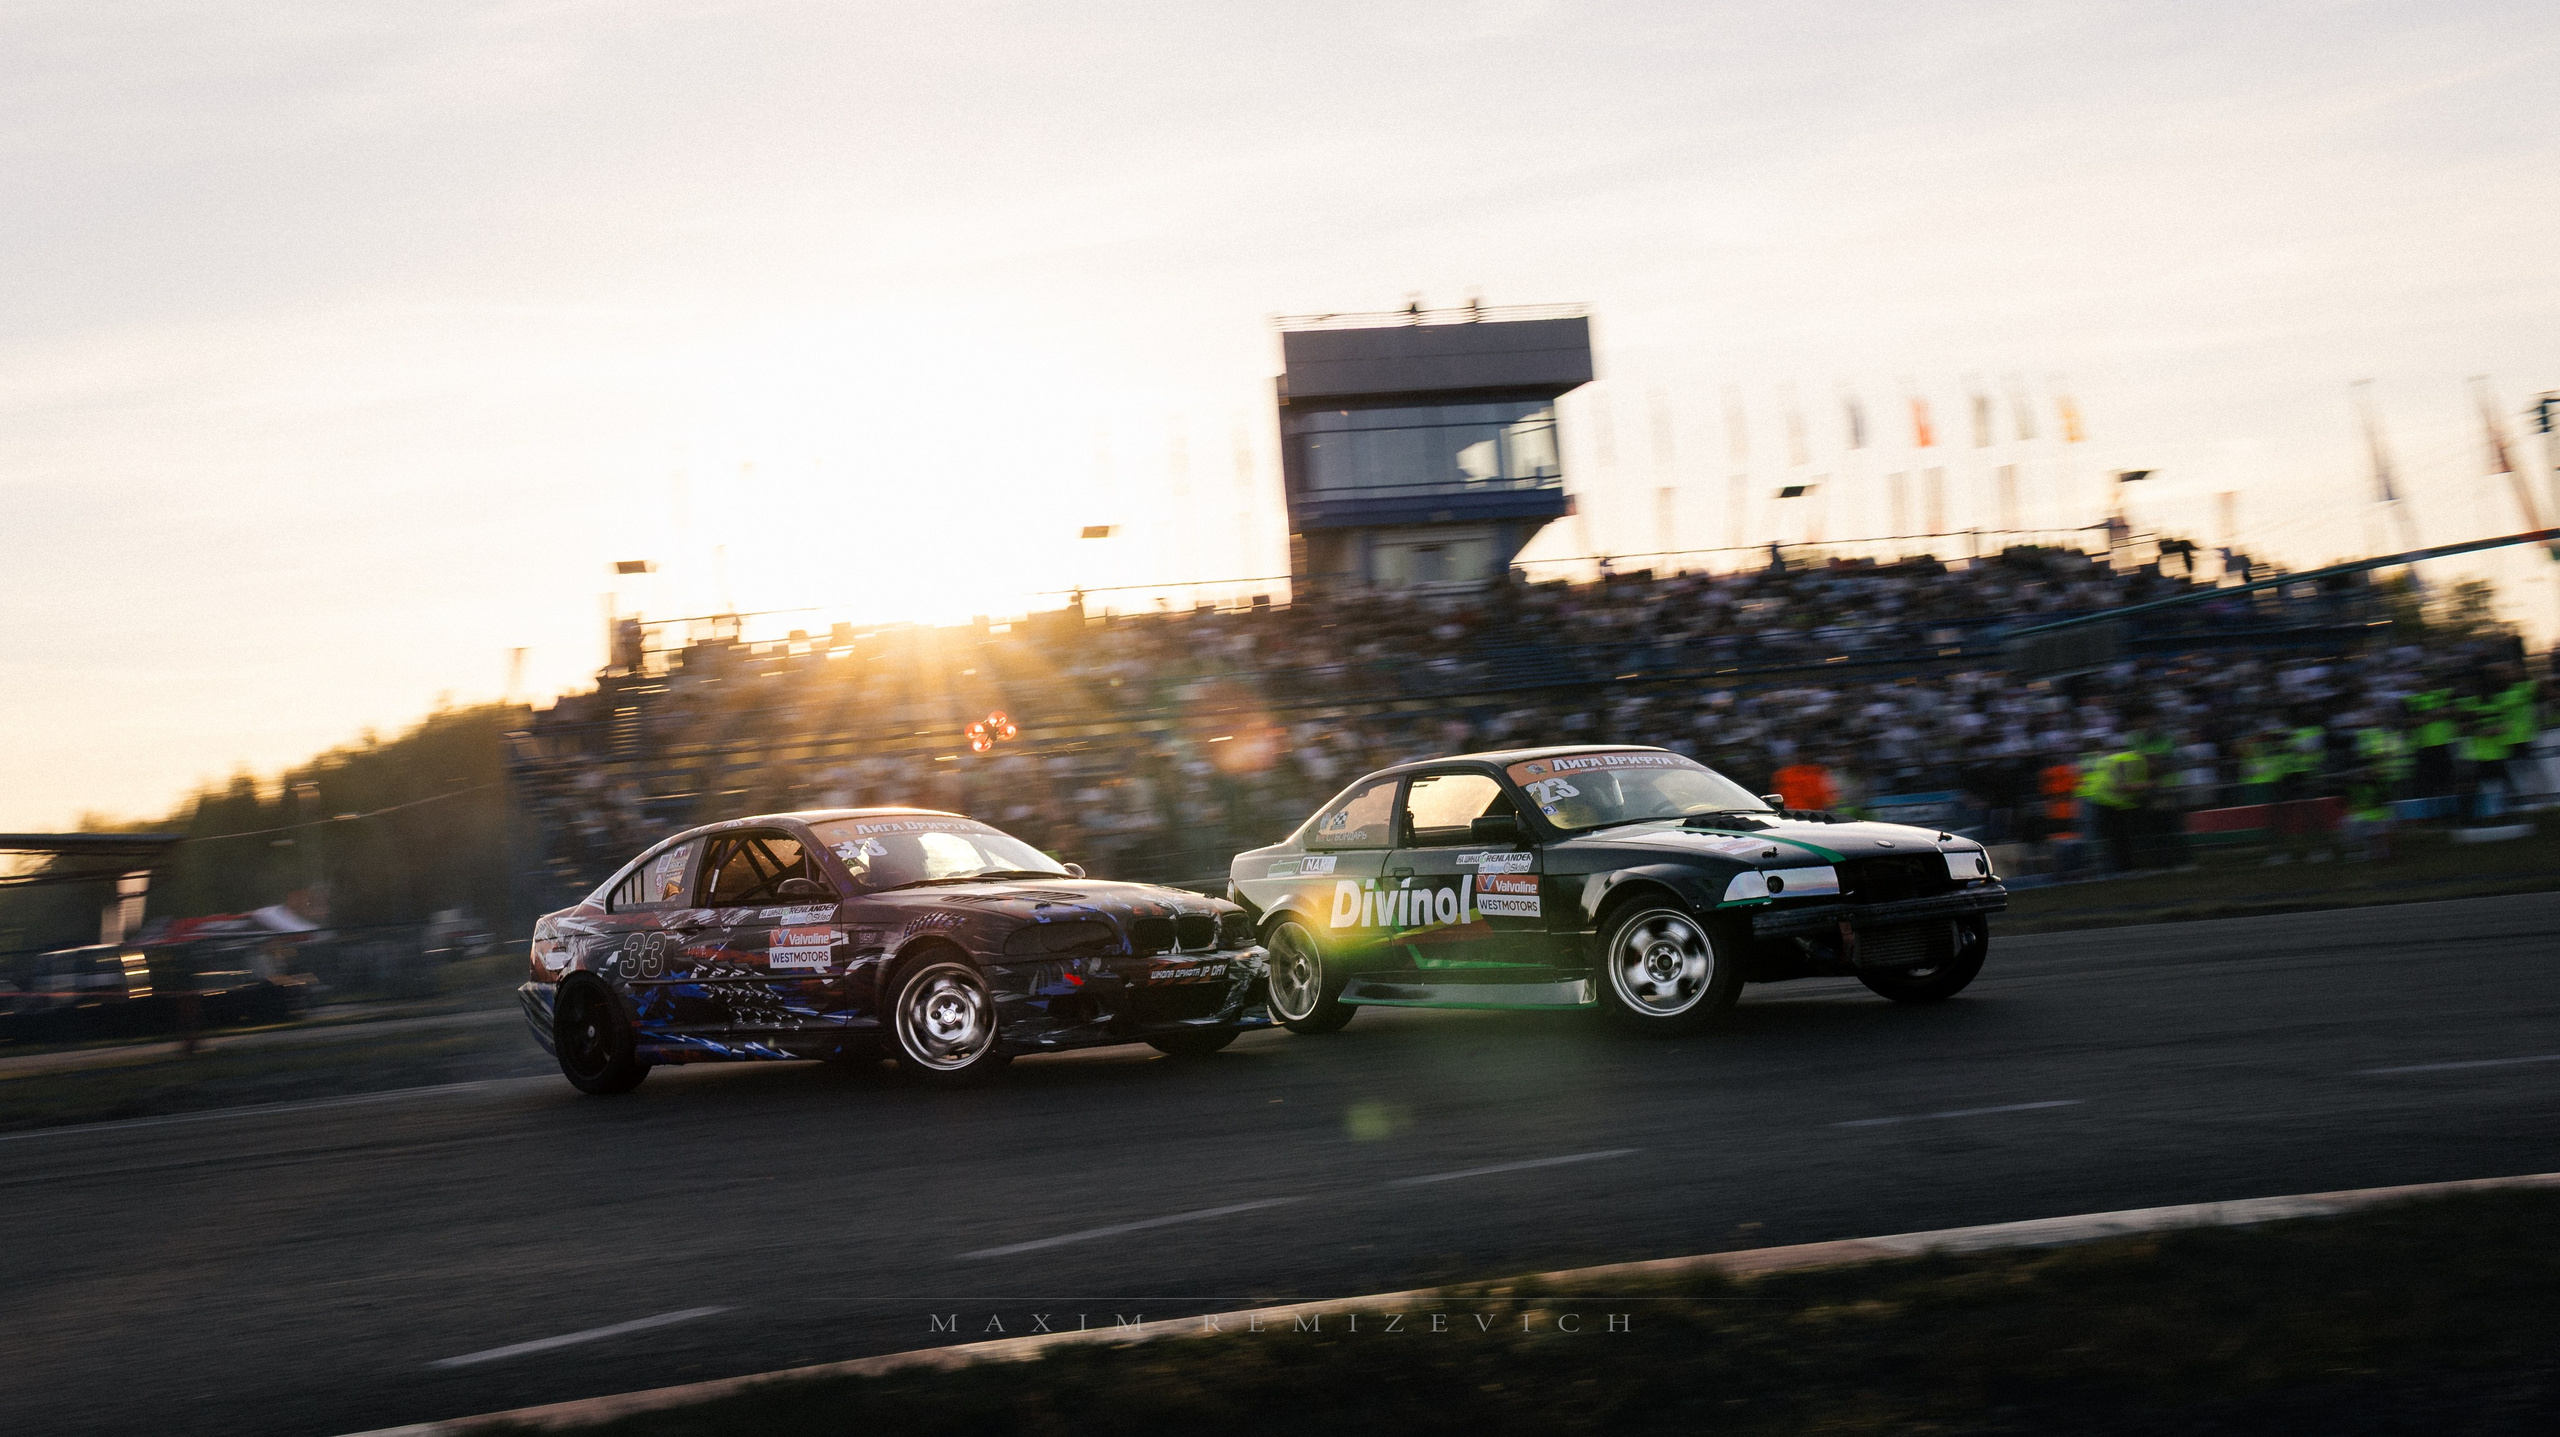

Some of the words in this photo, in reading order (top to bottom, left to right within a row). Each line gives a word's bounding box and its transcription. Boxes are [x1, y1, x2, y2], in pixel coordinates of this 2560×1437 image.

[1526, 777, 1580, 804] 23
[830, 837, 888, 859] 33
[1496, 880, 1537, 894] Valvoline
[1330, 874, 1472, 928] Divinol
[1480, 899, 1538, 911] WESTMOTORS
[789, 932, 829, 945] Valvoline
[620, 931, 666, 979] 33
[772, 951, 829, 963] WESTMOTORS
[1200, 965, 1211, 977] JP
[1211, 964, 1227, 976] DAY
